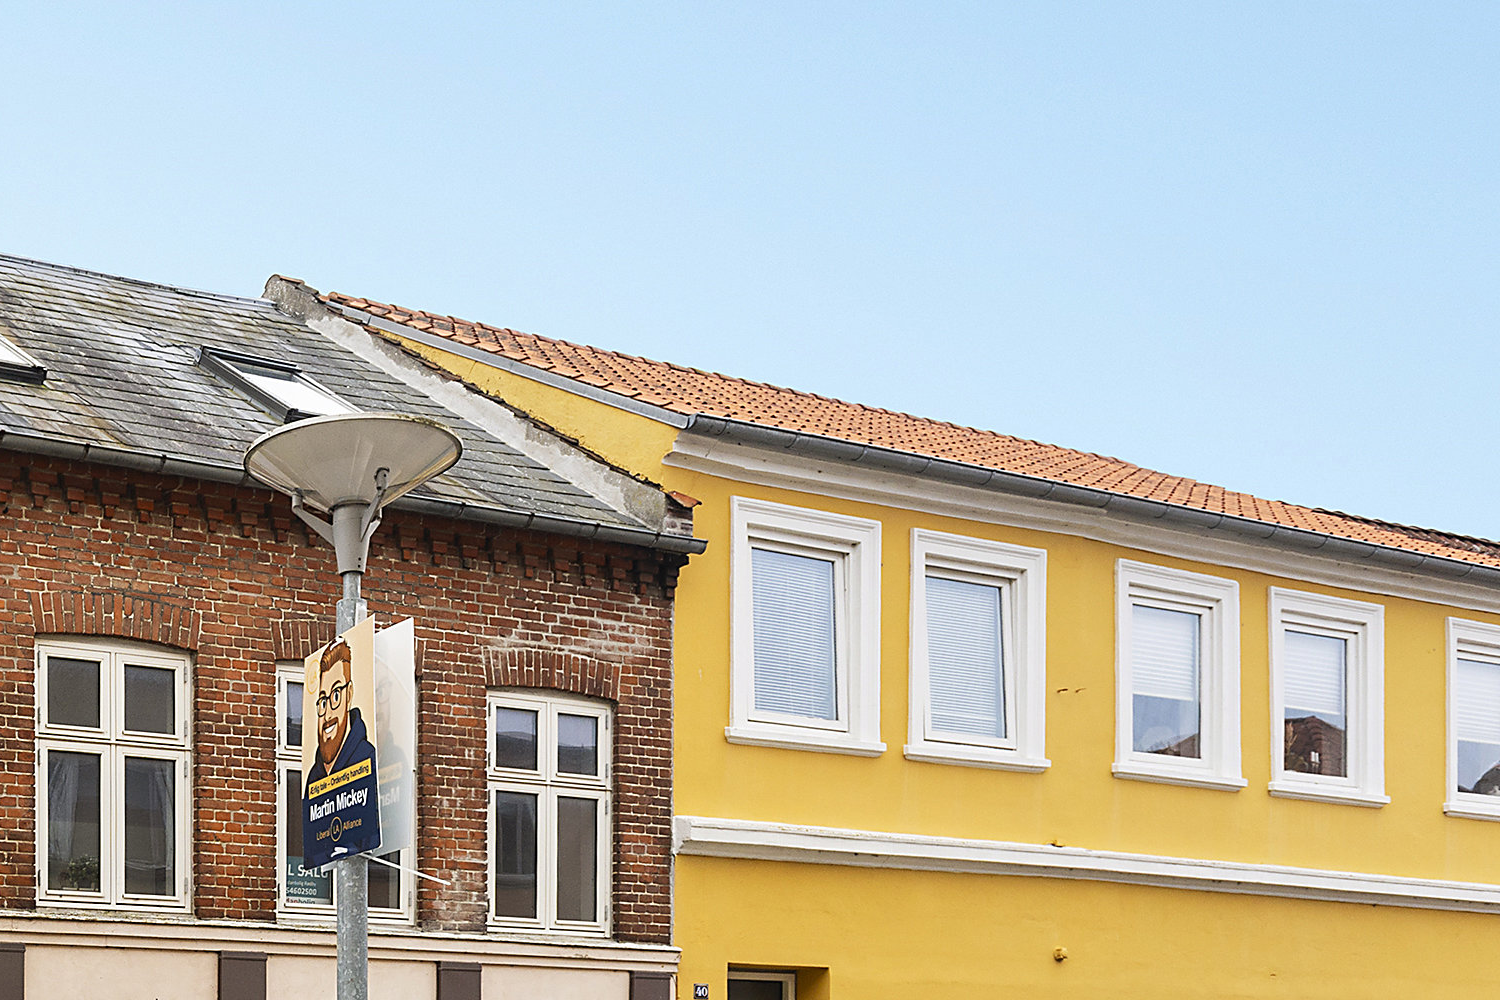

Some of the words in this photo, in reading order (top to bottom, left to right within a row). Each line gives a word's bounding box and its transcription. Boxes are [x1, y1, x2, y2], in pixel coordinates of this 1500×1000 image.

[309, 798, 335, 822] Martin
[336, 787, 368, 812] Mickey
[343, 817, 362, 831] Alliance
[695, 986, 708, 997] 40
